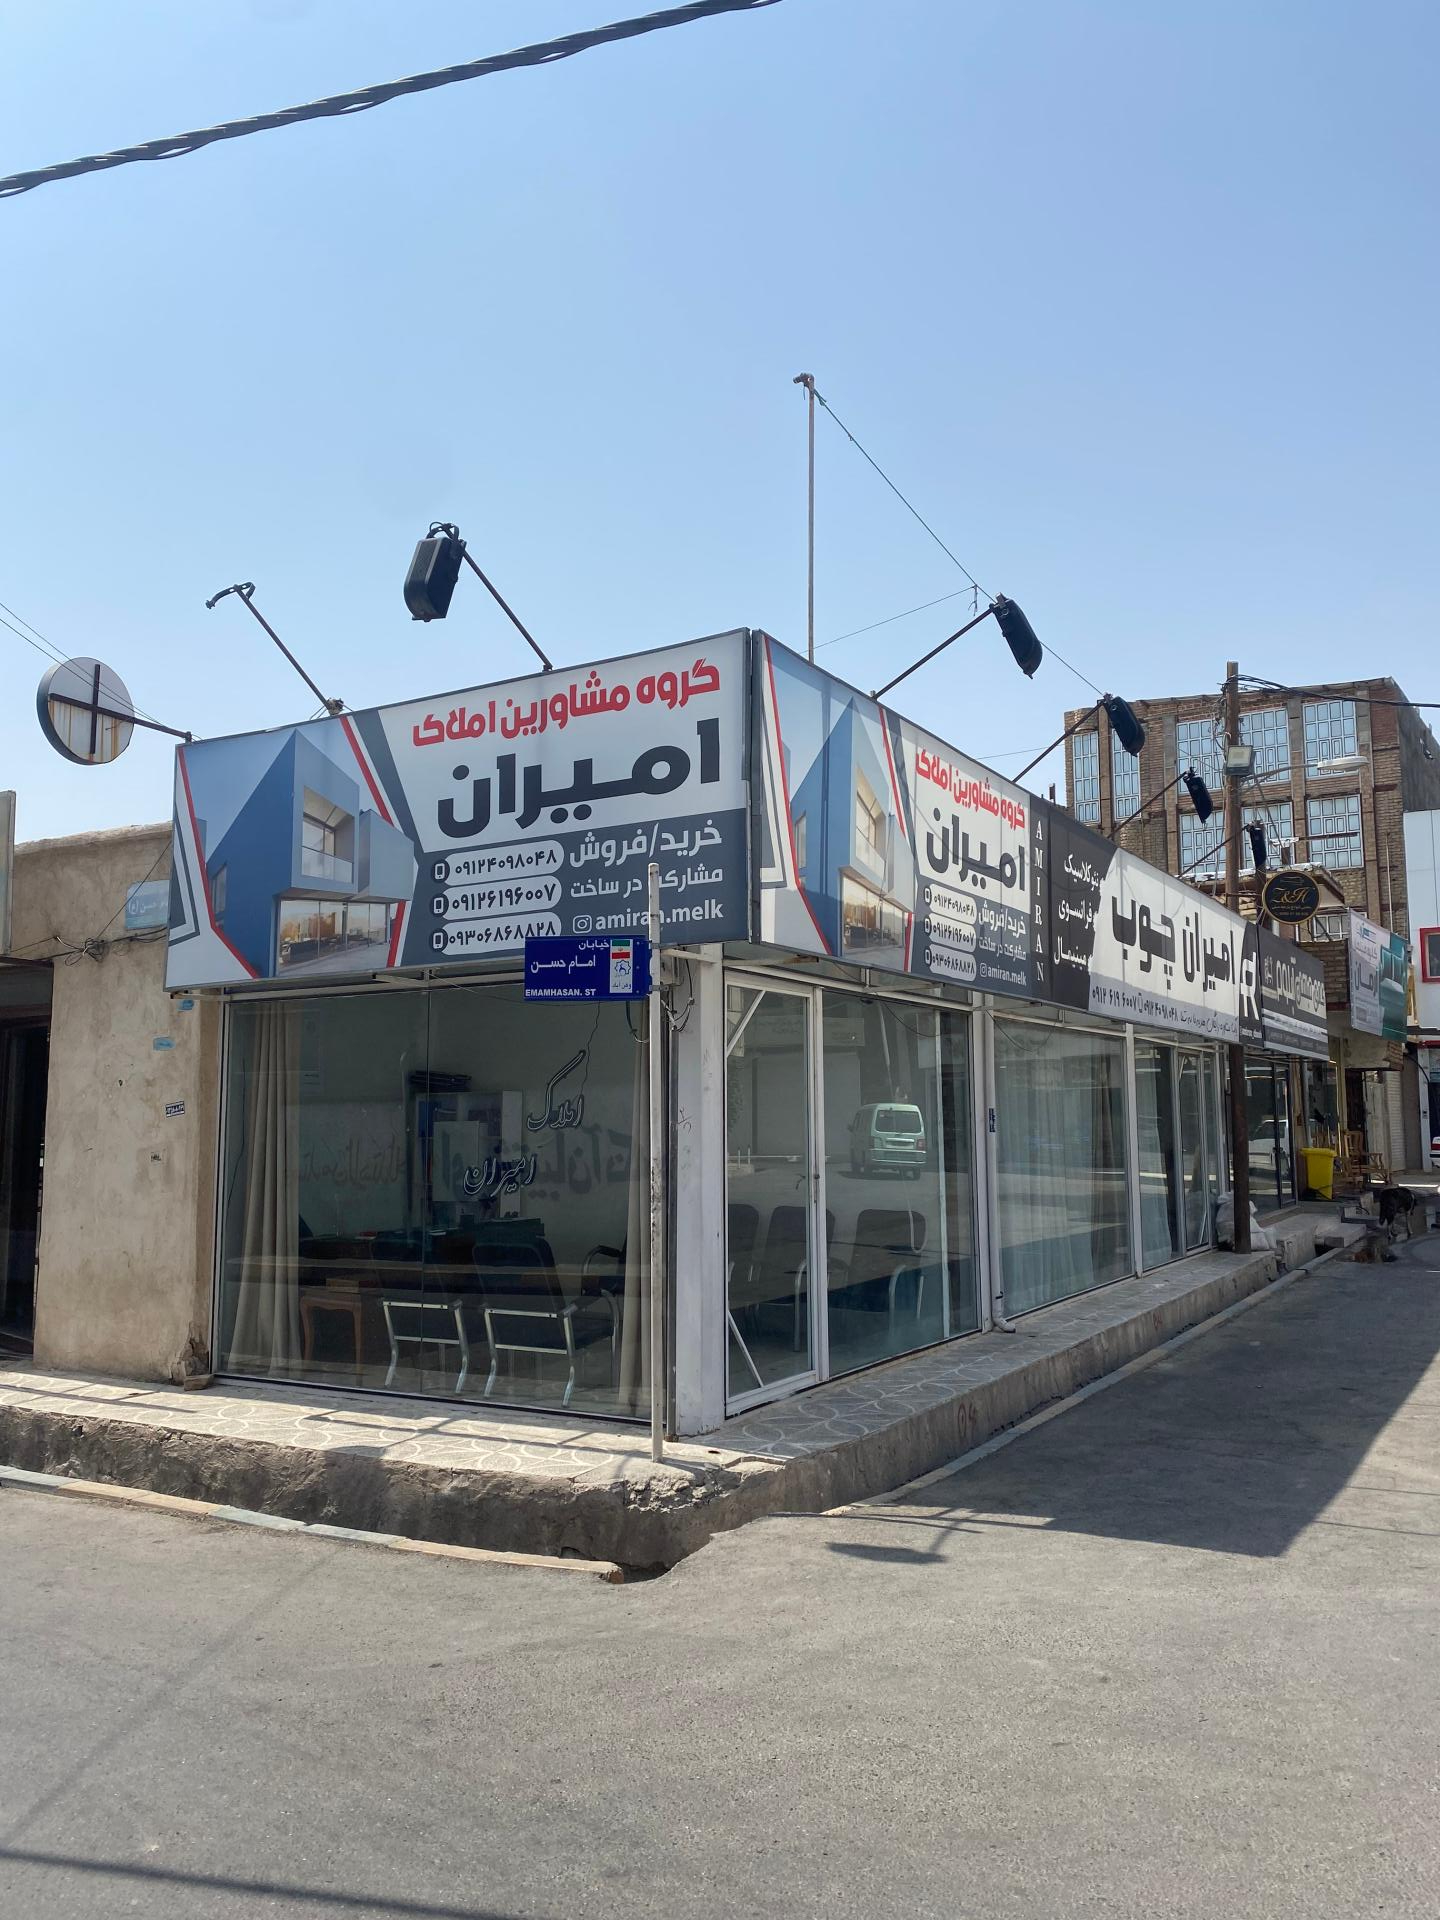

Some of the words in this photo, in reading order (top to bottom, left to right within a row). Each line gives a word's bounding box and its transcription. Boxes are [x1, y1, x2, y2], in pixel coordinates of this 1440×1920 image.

[636, 657, 720, 709] گروه
[500, 670, 630, 739] مشاورین
[412, 700, 497, 747] املاک
[437, 717, 720, 839] امیران
[915, 749, 953, 792] املاک
[953, 769, 999, 817] مشاورین
[1001, 799, 1025, 831] گروه
[455, 849, 557, 875] ۰۹۱۲۴۰۹۸۰۴۸
[926, 807, 1025, 892] امیران
[570, 878, 619, 898] ساخت
[623, 877, 643, 899] در
[657, 862, 723, 893] مشارک
[452, 883, 556, 911] ۰۹۱۲۶۱۹۶۰۰۷
[1058, 899, 1093, 930] فرانسوی
[578, 939, 610, 950] خیابان
[979, 936, 996, 952] ساخت
[1053, 935, 1087, 970] مینیمال
[1111, 895, 1176, 991] چوب
[1182, 911, 1236, 993] امیران
[530, 959, 567, 974] حسن
[568, 954, 596, 975] امام
[987, 965, 1027, 986] amiran.melk
[585, 988, 596, 996] ST
[462, 1152, 538, 1198] امیران
